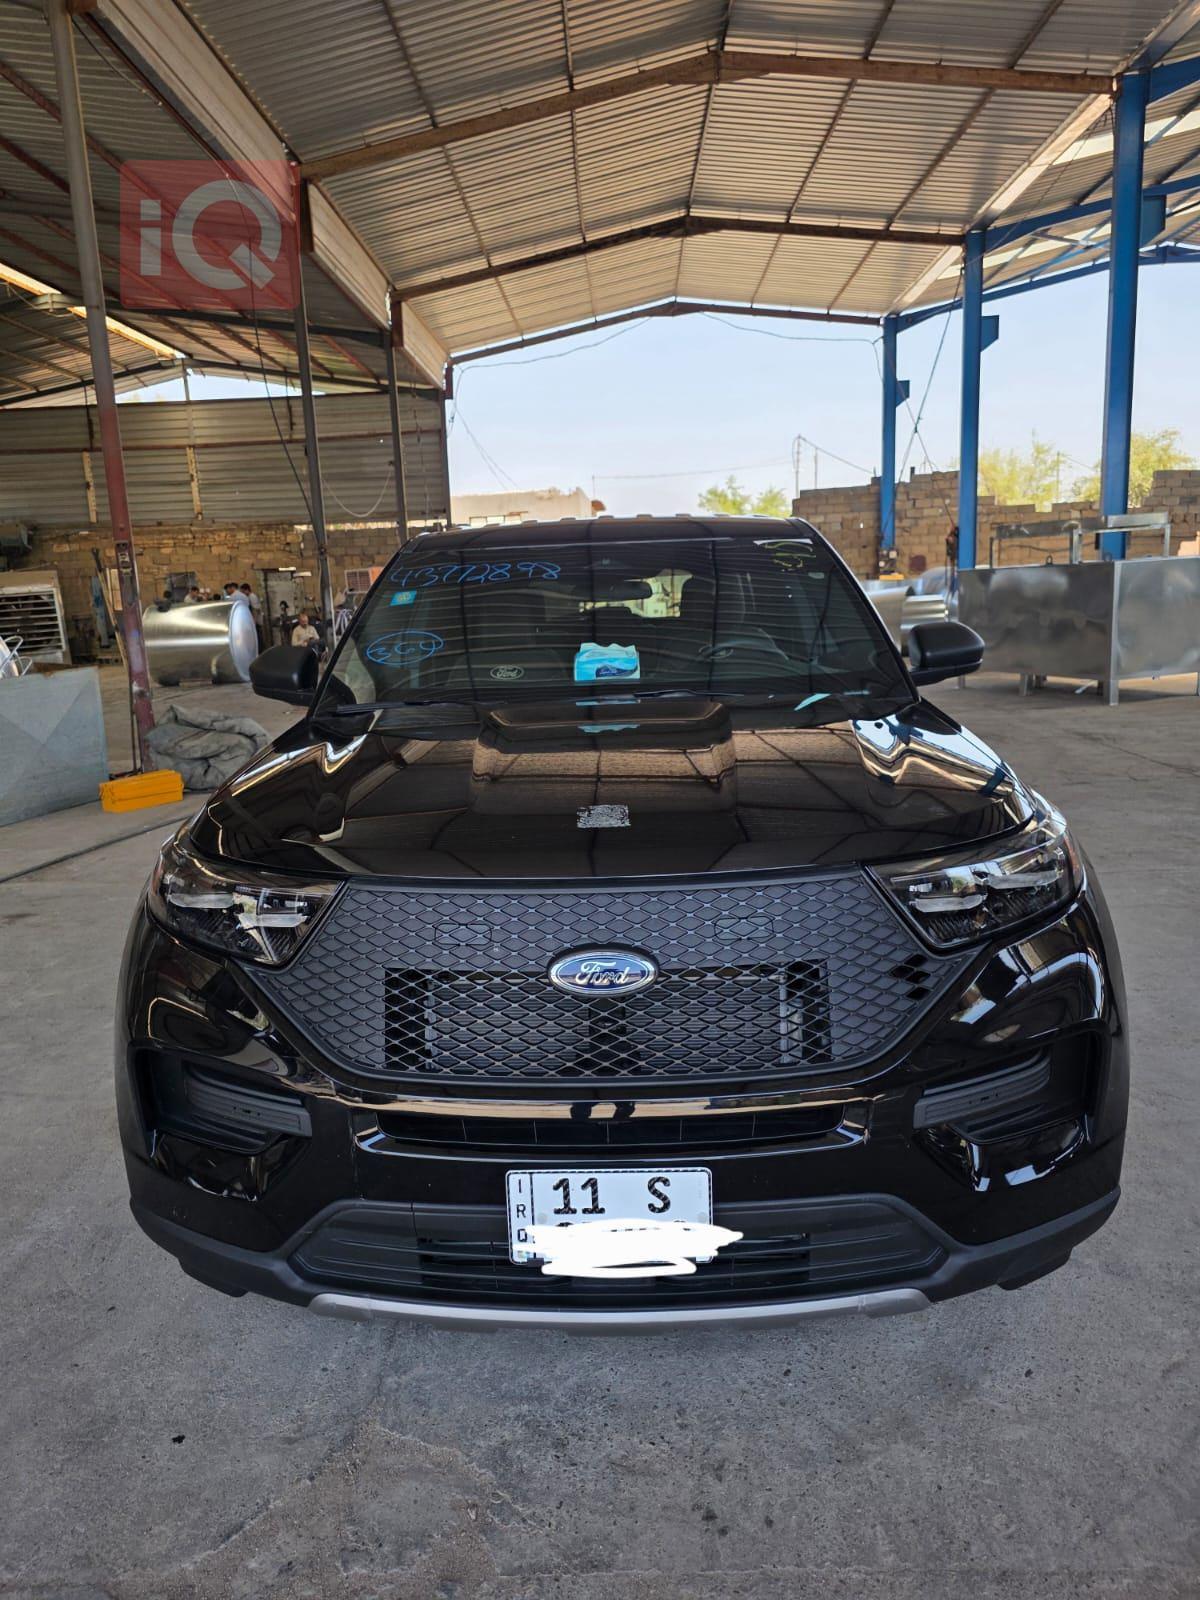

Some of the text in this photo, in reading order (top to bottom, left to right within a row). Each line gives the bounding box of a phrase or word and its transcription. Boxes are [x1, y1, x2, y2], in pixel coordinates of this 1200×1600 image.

[575, 961, 630, 985] Ford
[552, 1176, 672, 1214] 11 S
